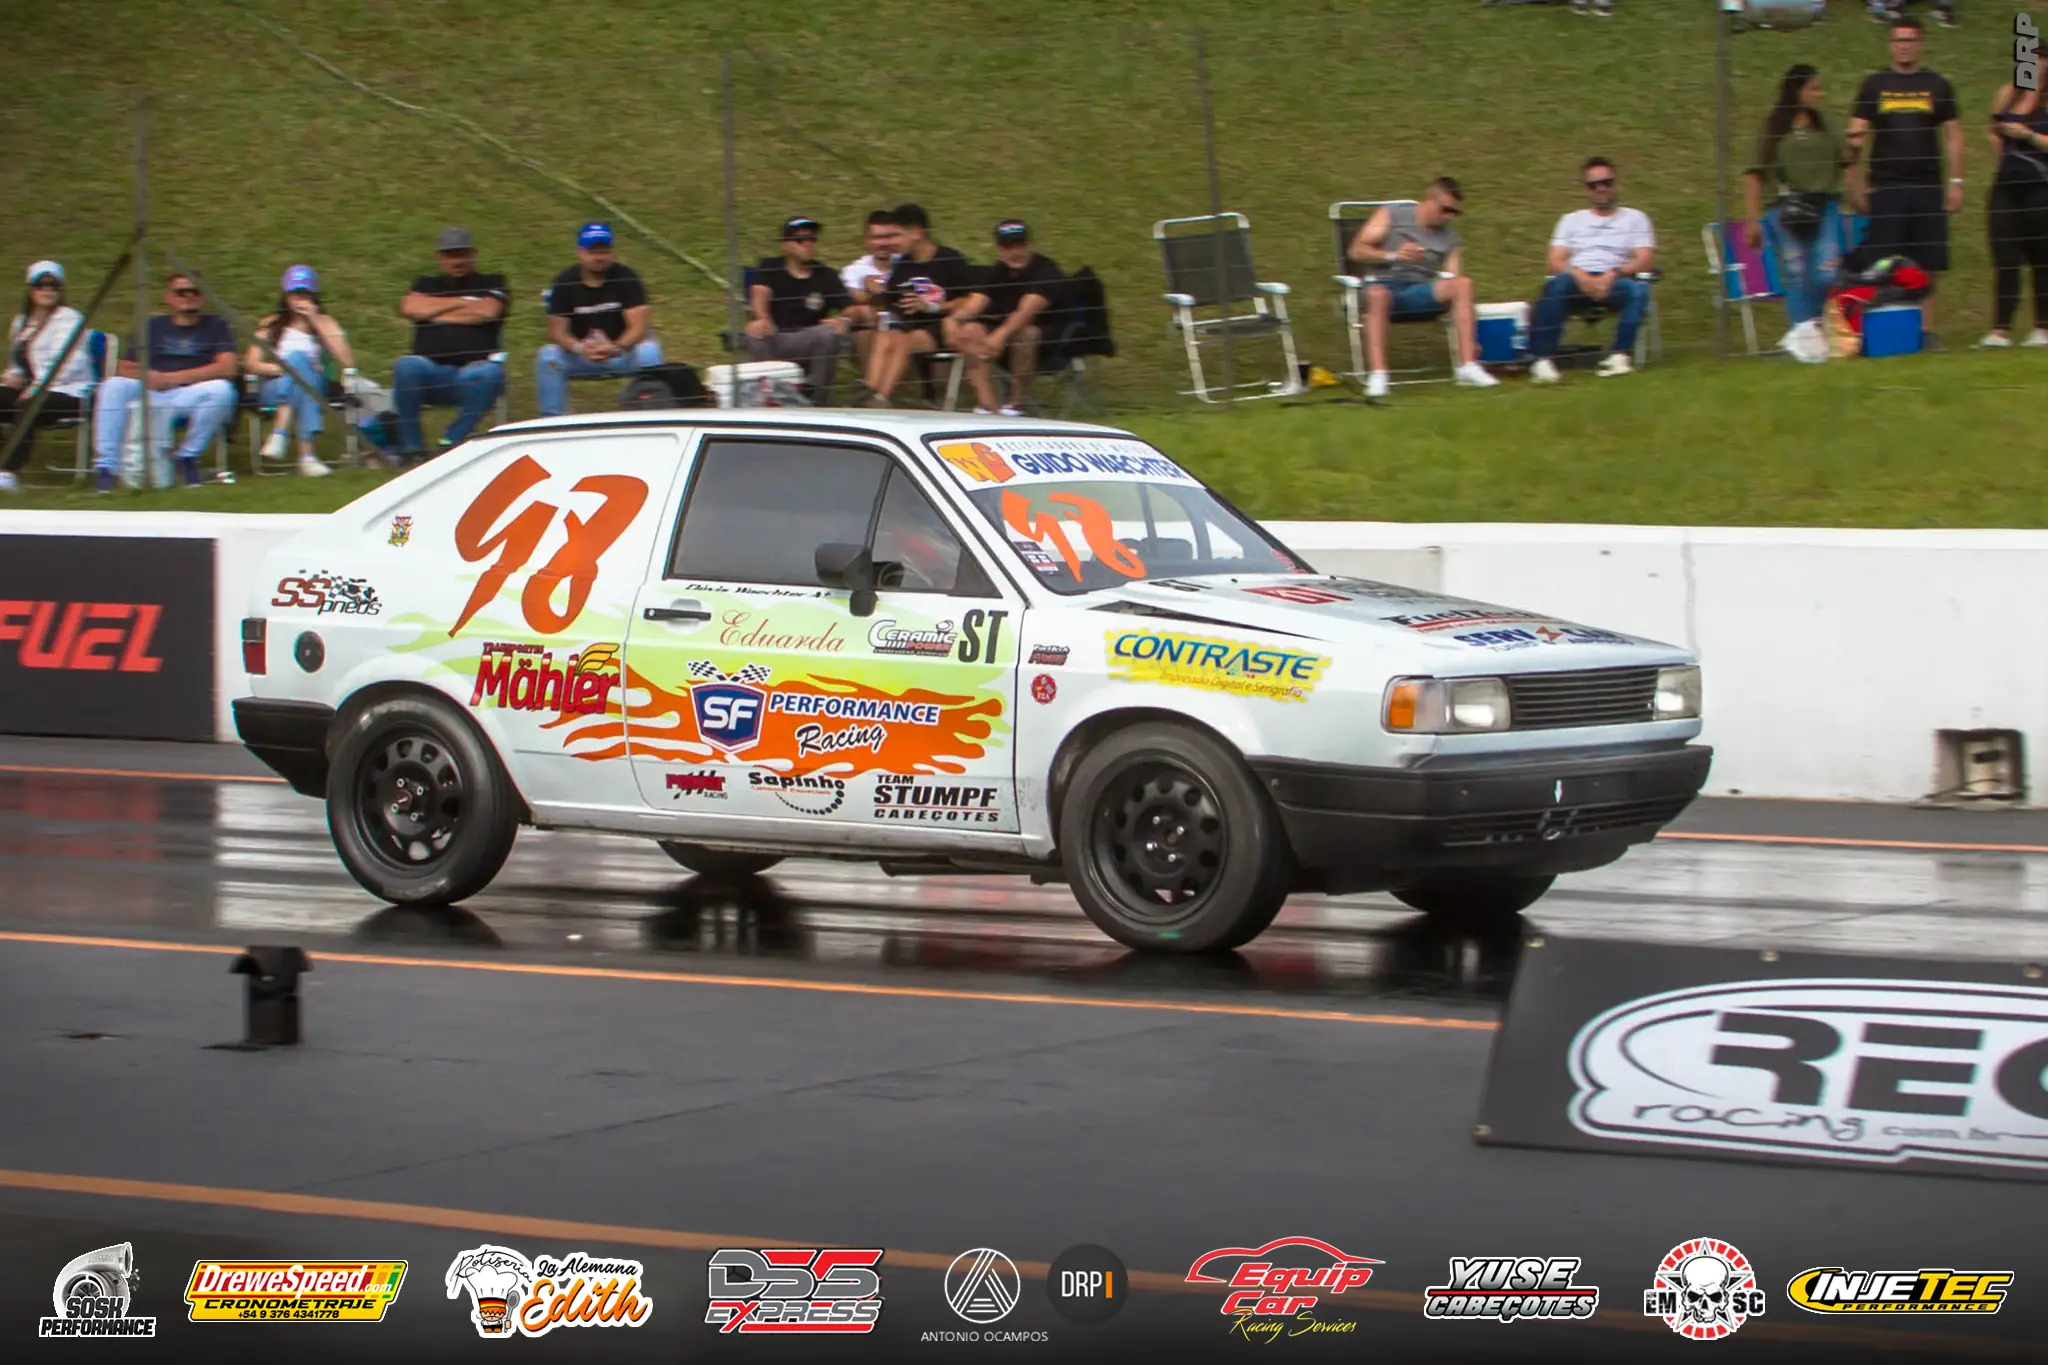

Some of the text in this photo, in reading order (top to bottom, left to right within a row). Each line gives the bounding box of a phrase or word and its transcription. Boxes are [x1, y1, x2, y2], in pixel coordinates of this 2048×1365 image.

[1011, 452, 1189, 479] GUIDO WAECHTER
[448, 455, 649, 638] 98
[1002, 489, 1146, 583] 98
[271, 577, 332, 608] SS
[317, 599, 382, 615] pneus
[720, 610, 845, 652] Eduarda
[958, 609, 1008, 664] ST
[1114, 633, 1319, 680] CONTRASTE
[469, 651, 621, 714] Mähler
[703, 696, 758, 730] SF
[769, 694, 939, 723] PERFORMANCE
[796, 724, 885, 756] Racing
[748, 771, 845, 789] Sapinho
[877, 775, 914, 784] TEAM
[873, 785, 998, 807] STUMPF
[874, 808, 999, 822] CABEÇOTES
[1634, 1102, 1866, 1143] racing
